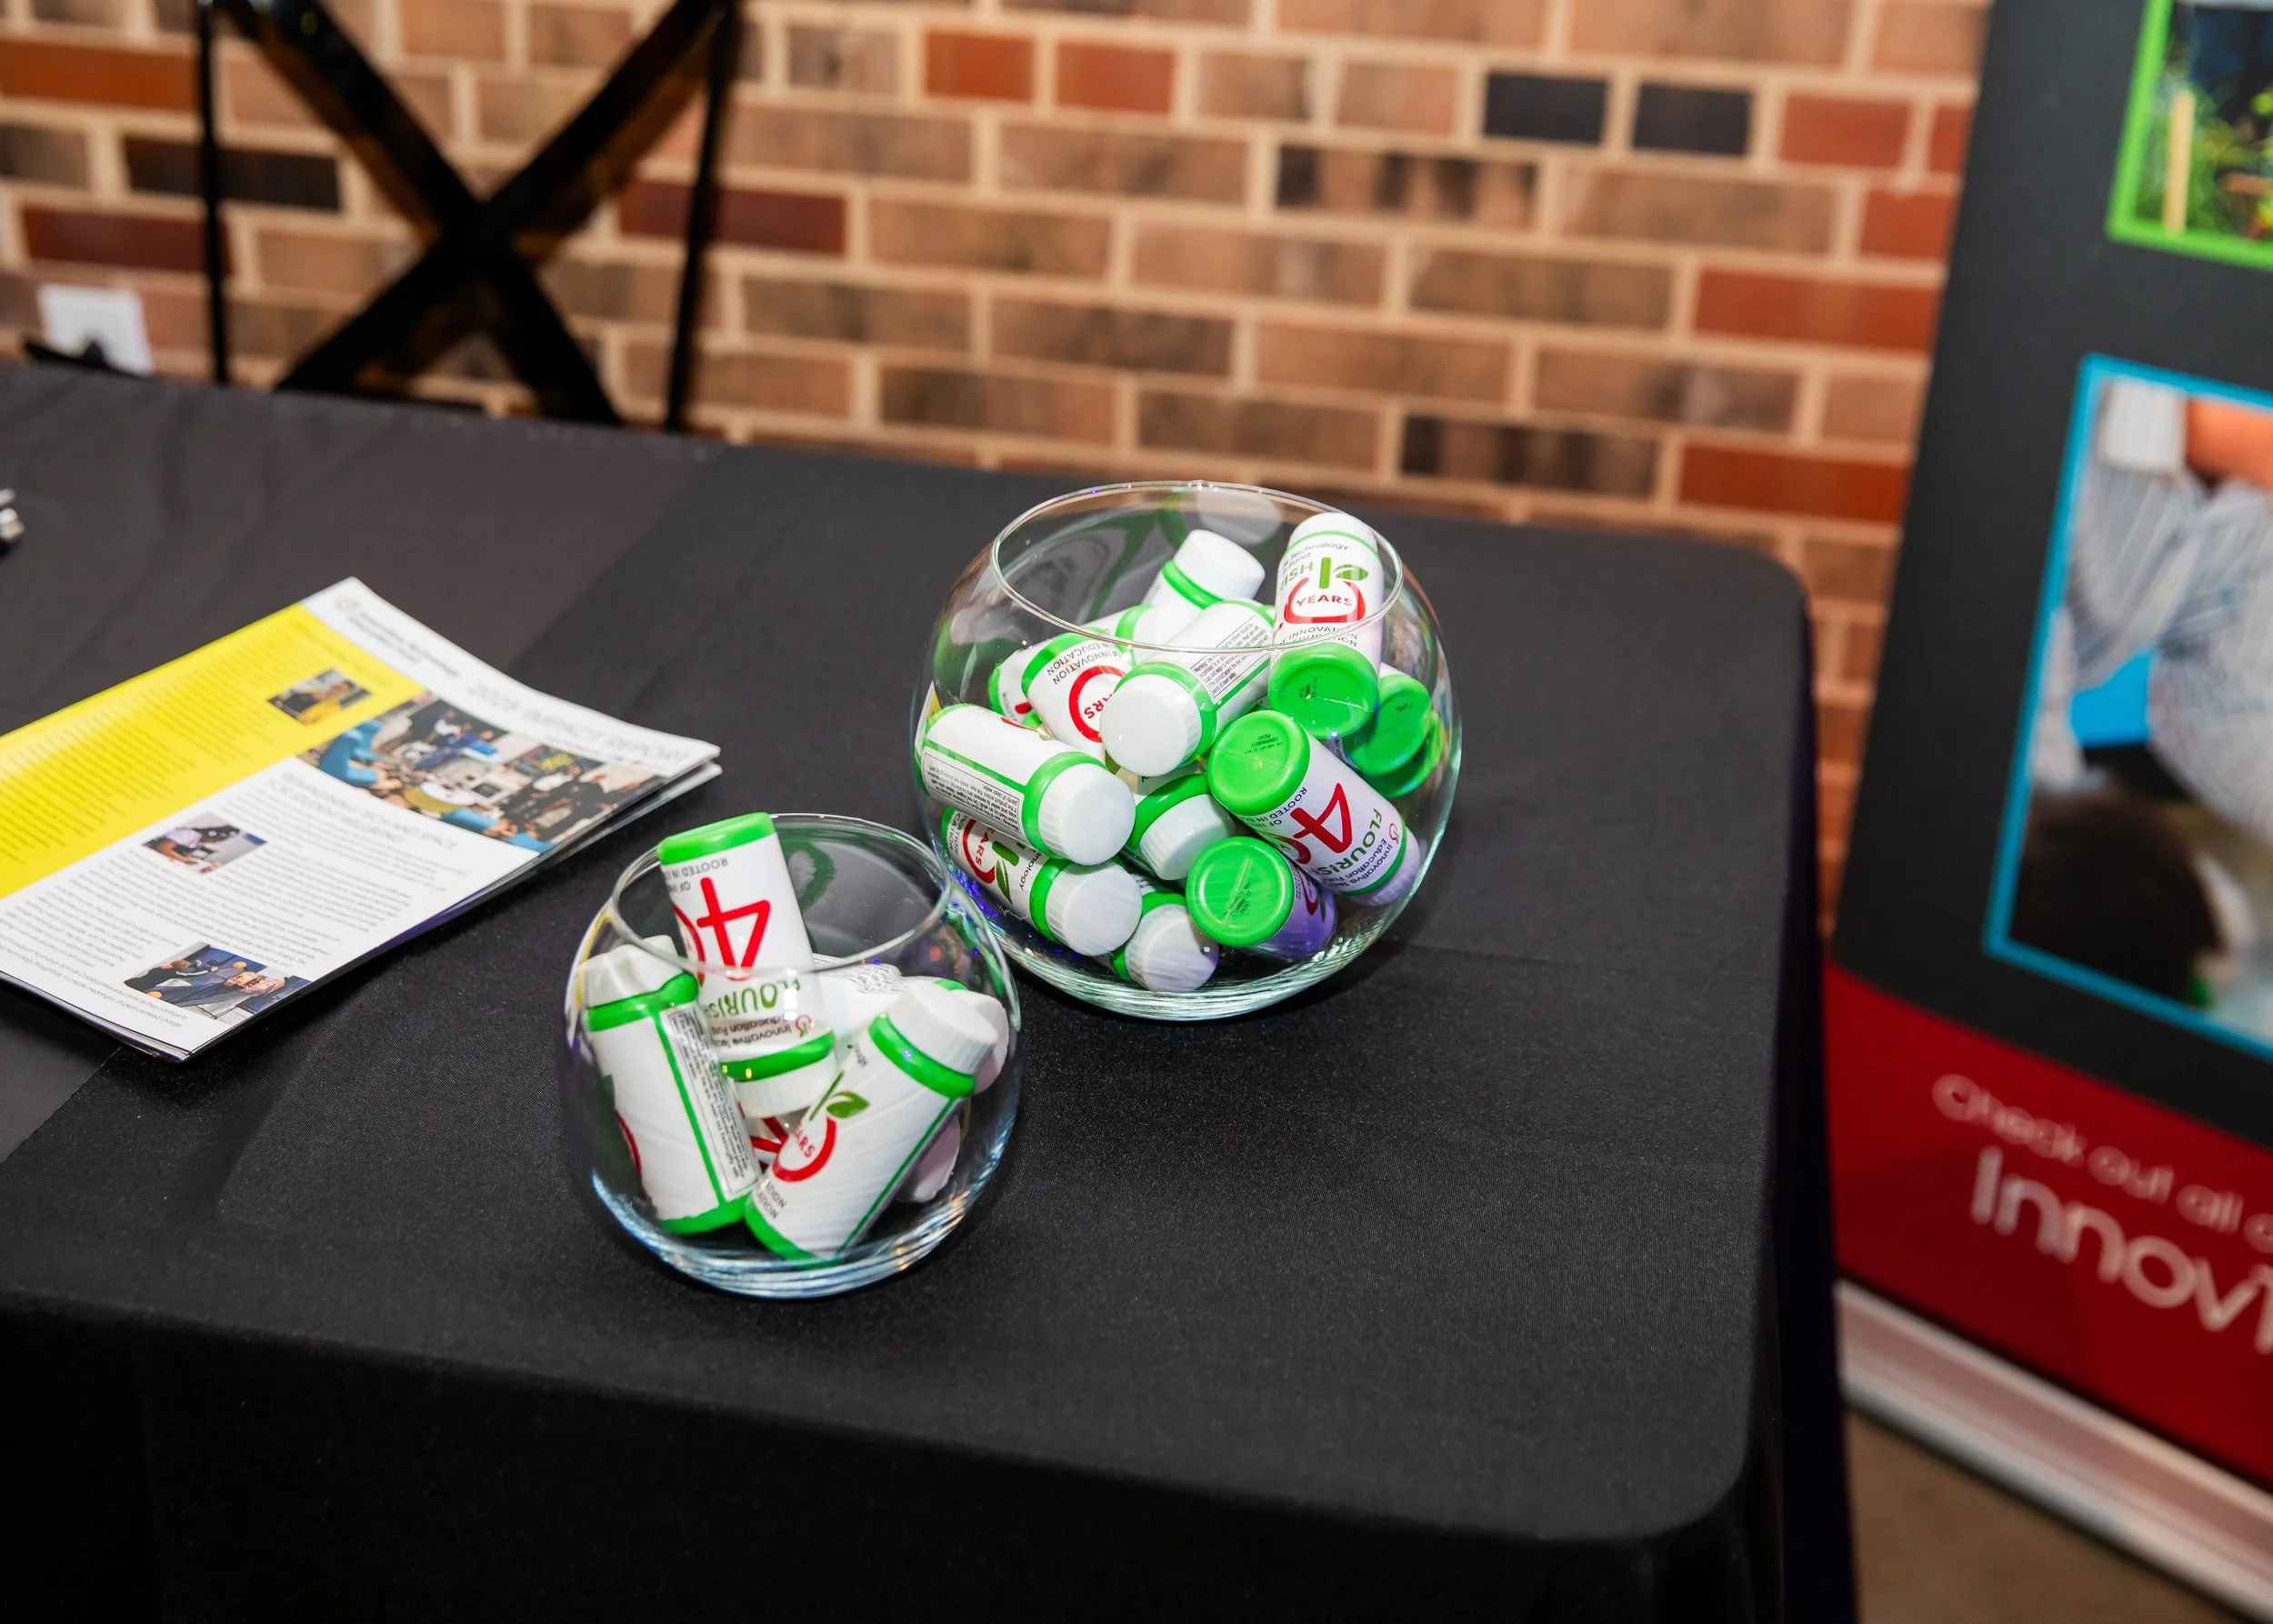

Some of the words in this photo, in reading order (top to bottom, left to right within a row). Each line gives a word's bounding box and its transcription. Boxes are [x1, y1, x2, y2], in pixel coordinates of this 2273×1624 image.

[1297, 594, 1353, 607] YEARS
[1047, 641, 1104, 677] EDUCATION
[1053, 651, 1111, 685] INNOVATION
[1269, 787, 1307, 819] ROOTED
[1269, 819, 1282, 827] OF
[1318, 807, 1382, 875] FLOURIS
[683, 857, 729, 877] ROOTED
[1346, 838, 1387, 880] Education
[1350, 844, 1393, 885] Innovative
[679, 881, 692, 891] OF
[732, 1024, 792, 1045] Innovative
[1932, 1074, 2088, 1168] Check
[2087, 1146, 2175, 1205] out
